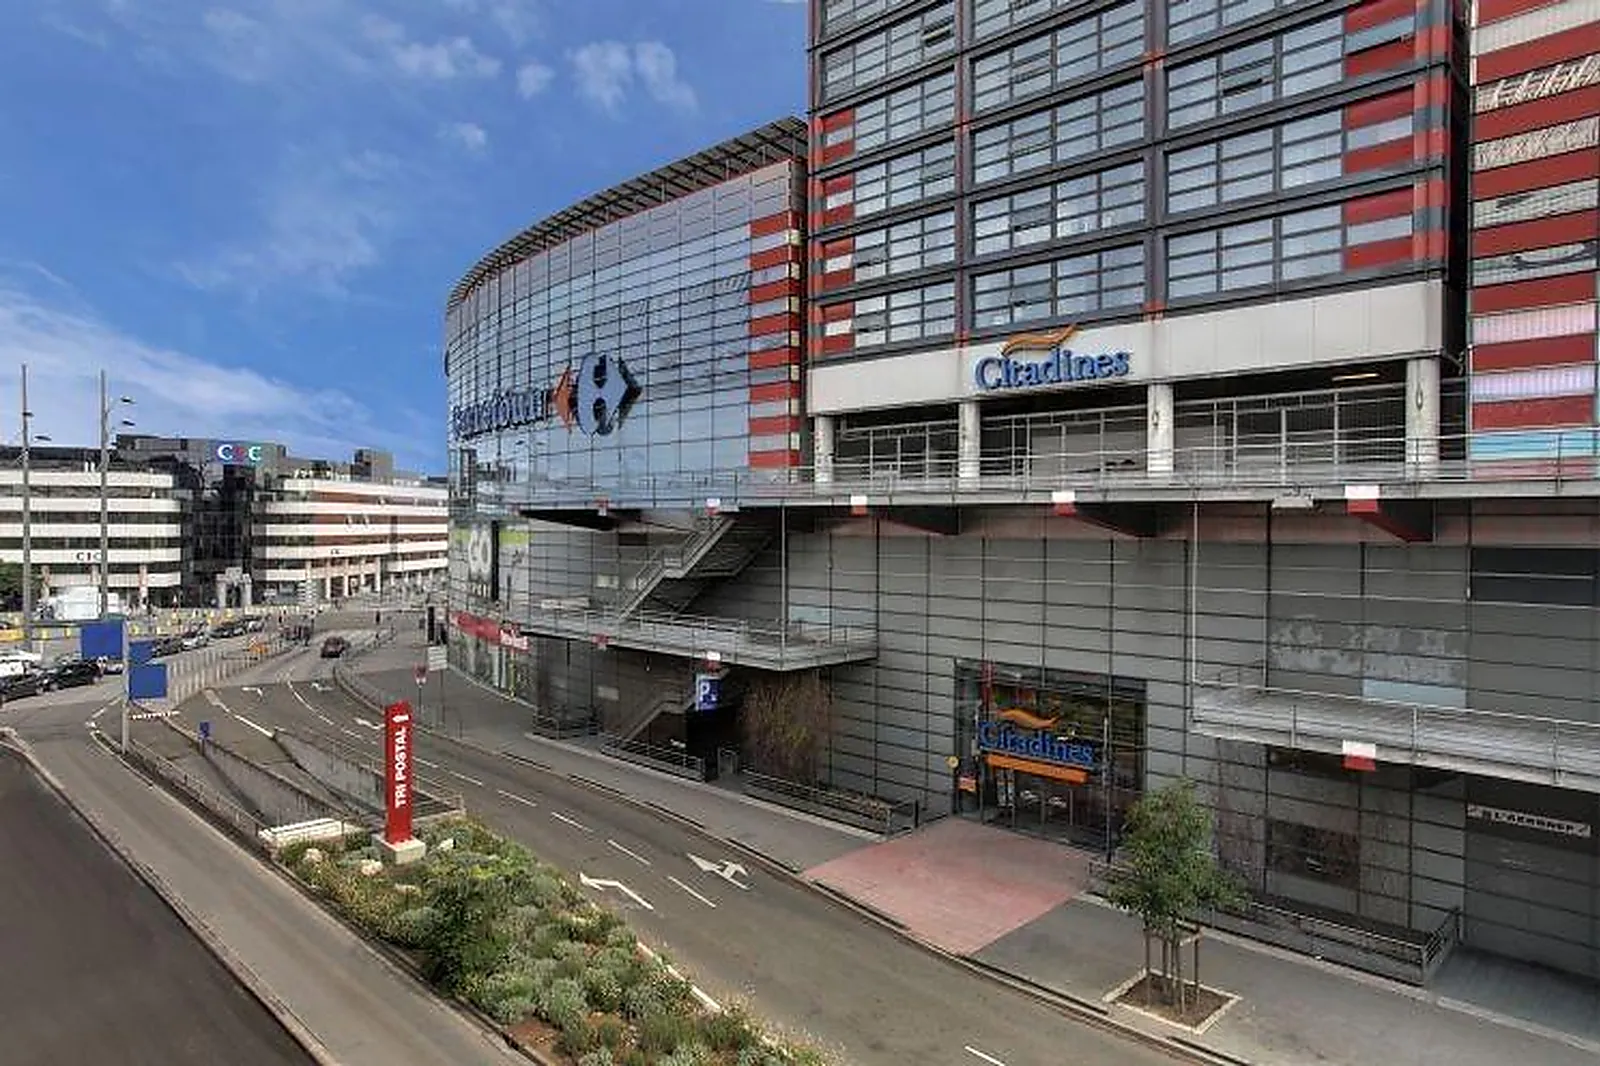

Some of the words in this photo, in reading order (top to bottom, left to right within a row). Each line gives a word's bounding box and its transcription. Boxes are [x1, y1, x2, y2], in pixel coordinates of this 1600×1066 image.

[975, 347, 1131, 390] Citadines
[394, 725, 407, 782] POSTAL
[979, 720, 1094, 765] Citadines
[394, 783, 407, 809] TRI
